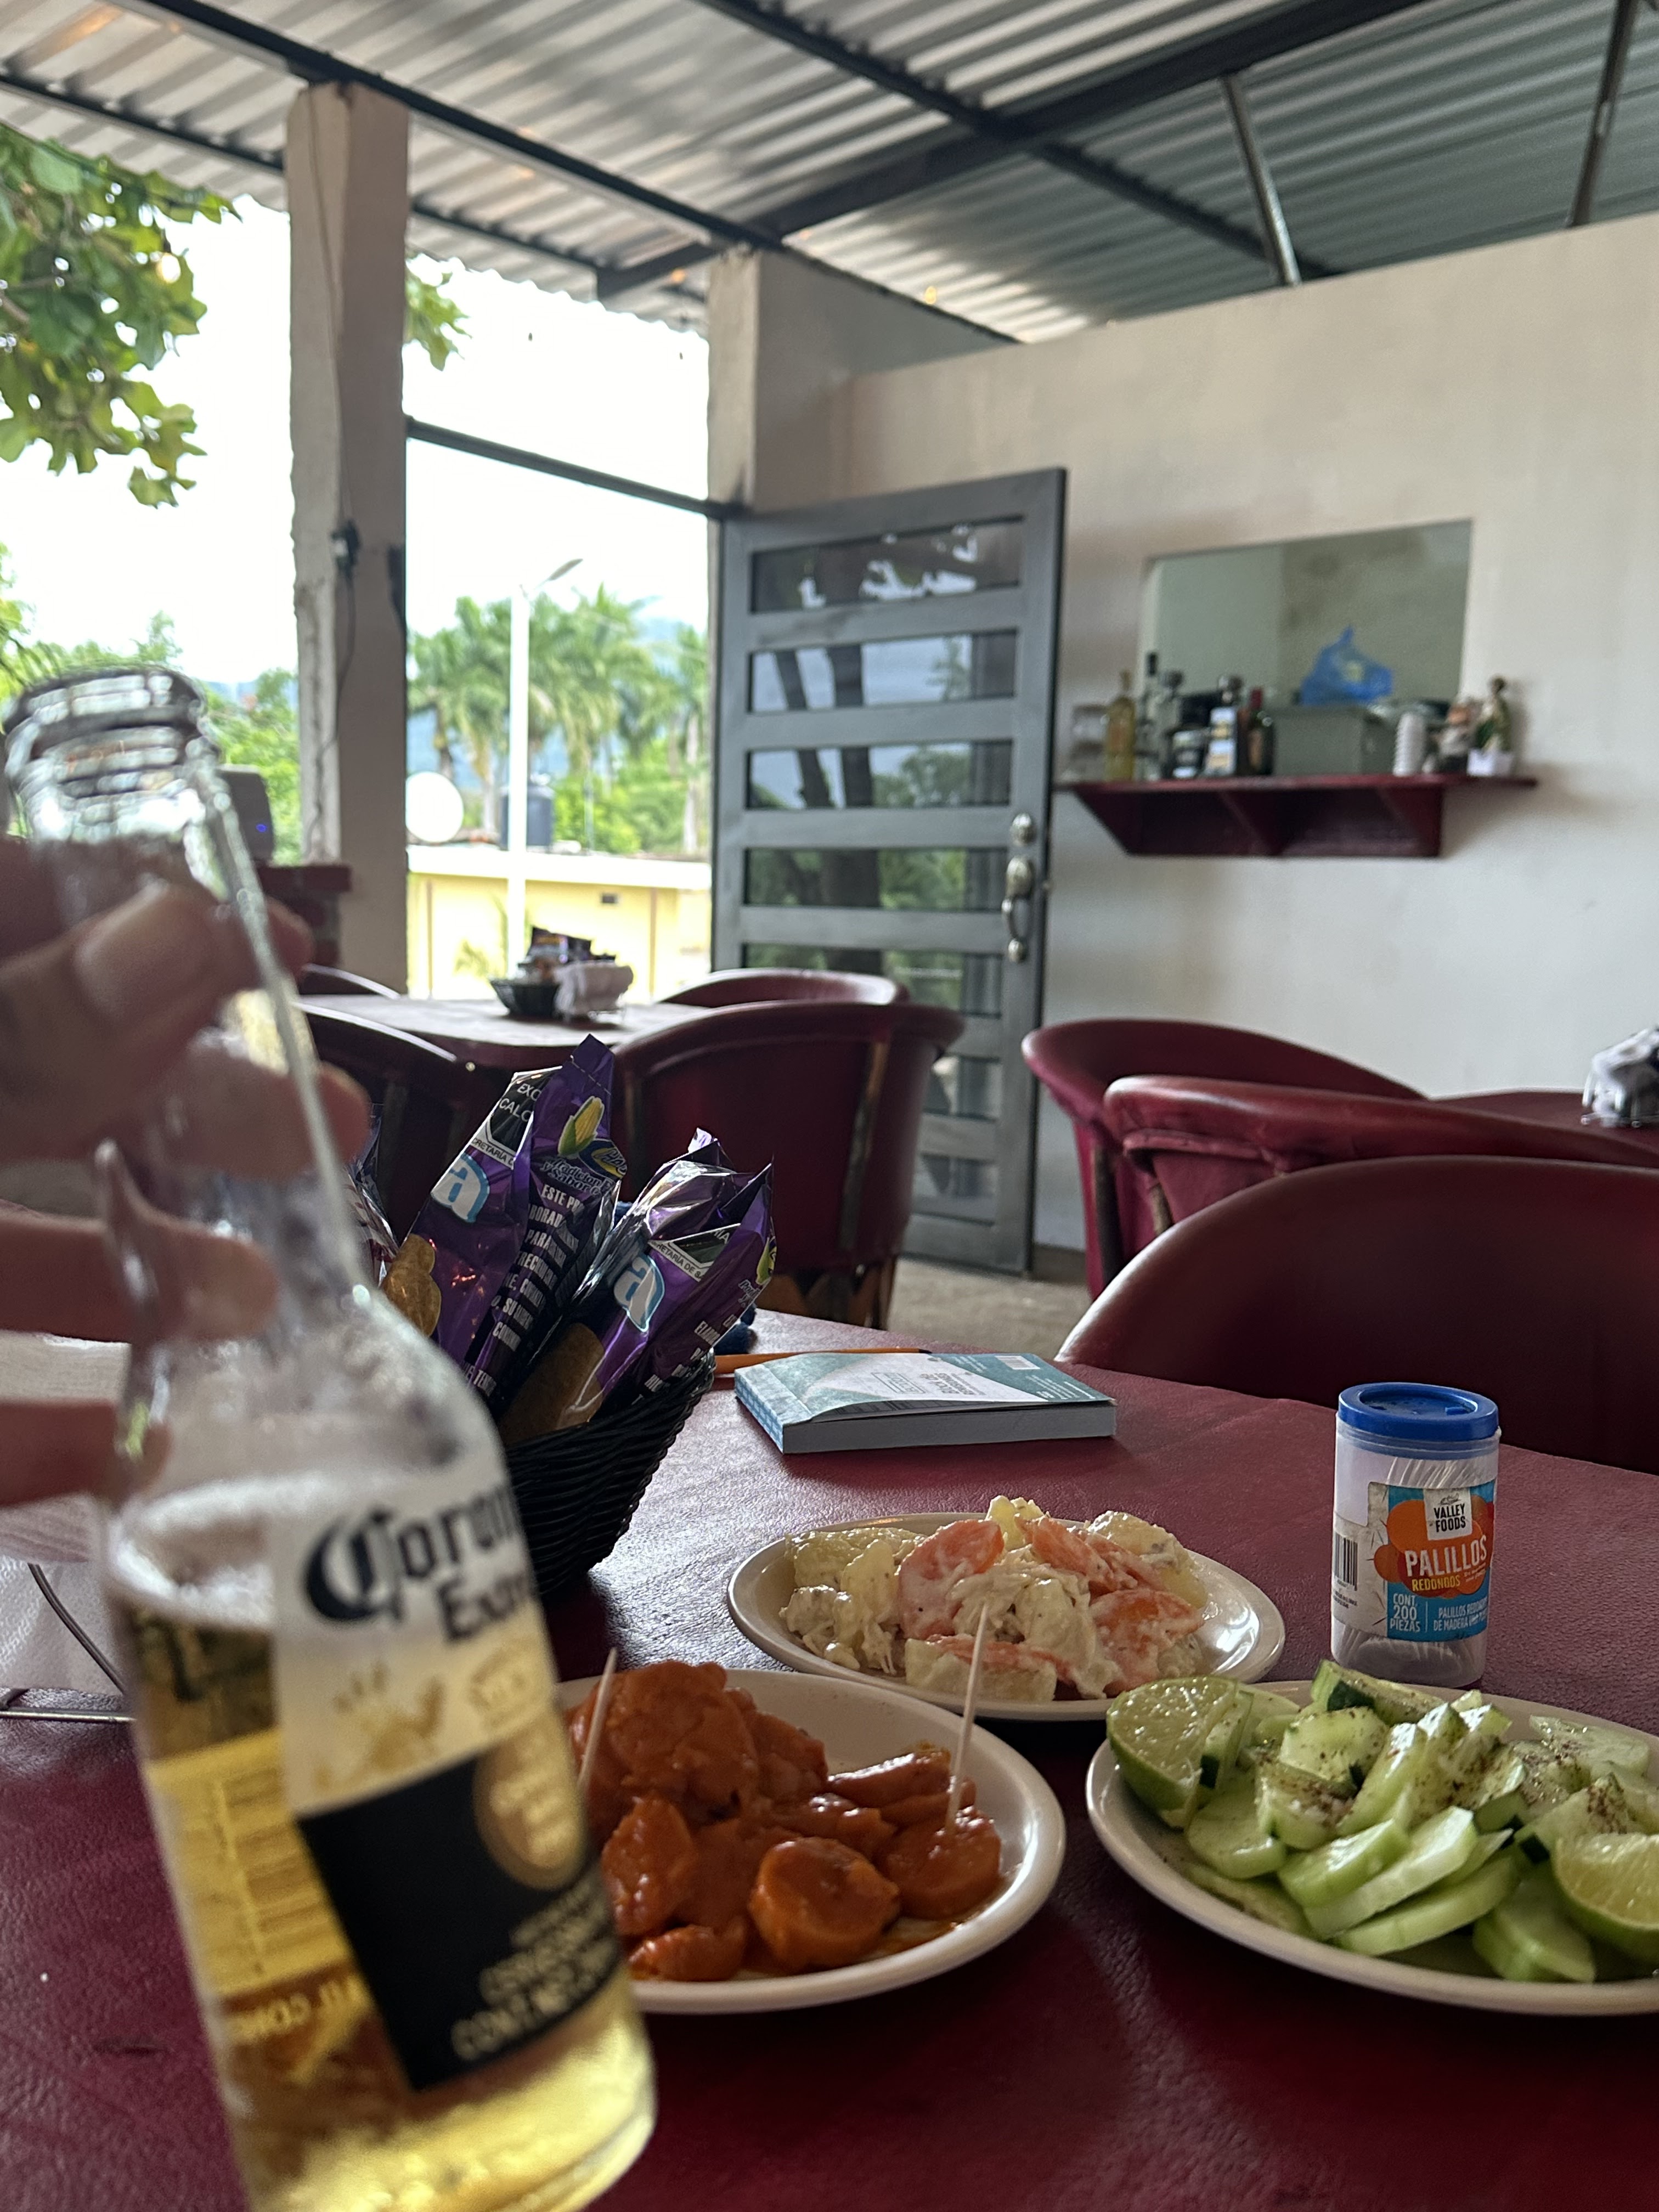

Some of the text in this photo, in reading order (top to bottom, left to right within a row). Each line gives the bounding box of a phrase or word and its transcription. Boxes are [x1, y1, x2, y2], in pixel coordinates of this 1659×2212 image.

[541, 1184, 567, 1206] ESTE
[1434, 1503, 1465, 1519] VALLEY
[1436, 1516, 1466, 1533] FOODS
[1404, 1534, 1487, 1578] PALILLOS
[1412, 1575, 1460, 1592] REDONDOS
[1393, 1605, 1417, 1621] 200
[1438, 1605, 1466, 1619] PALILLOS
[1390, 1618, 1421, 1633] PIEZAS
[1434, 1620, 1443, 1631] DE
